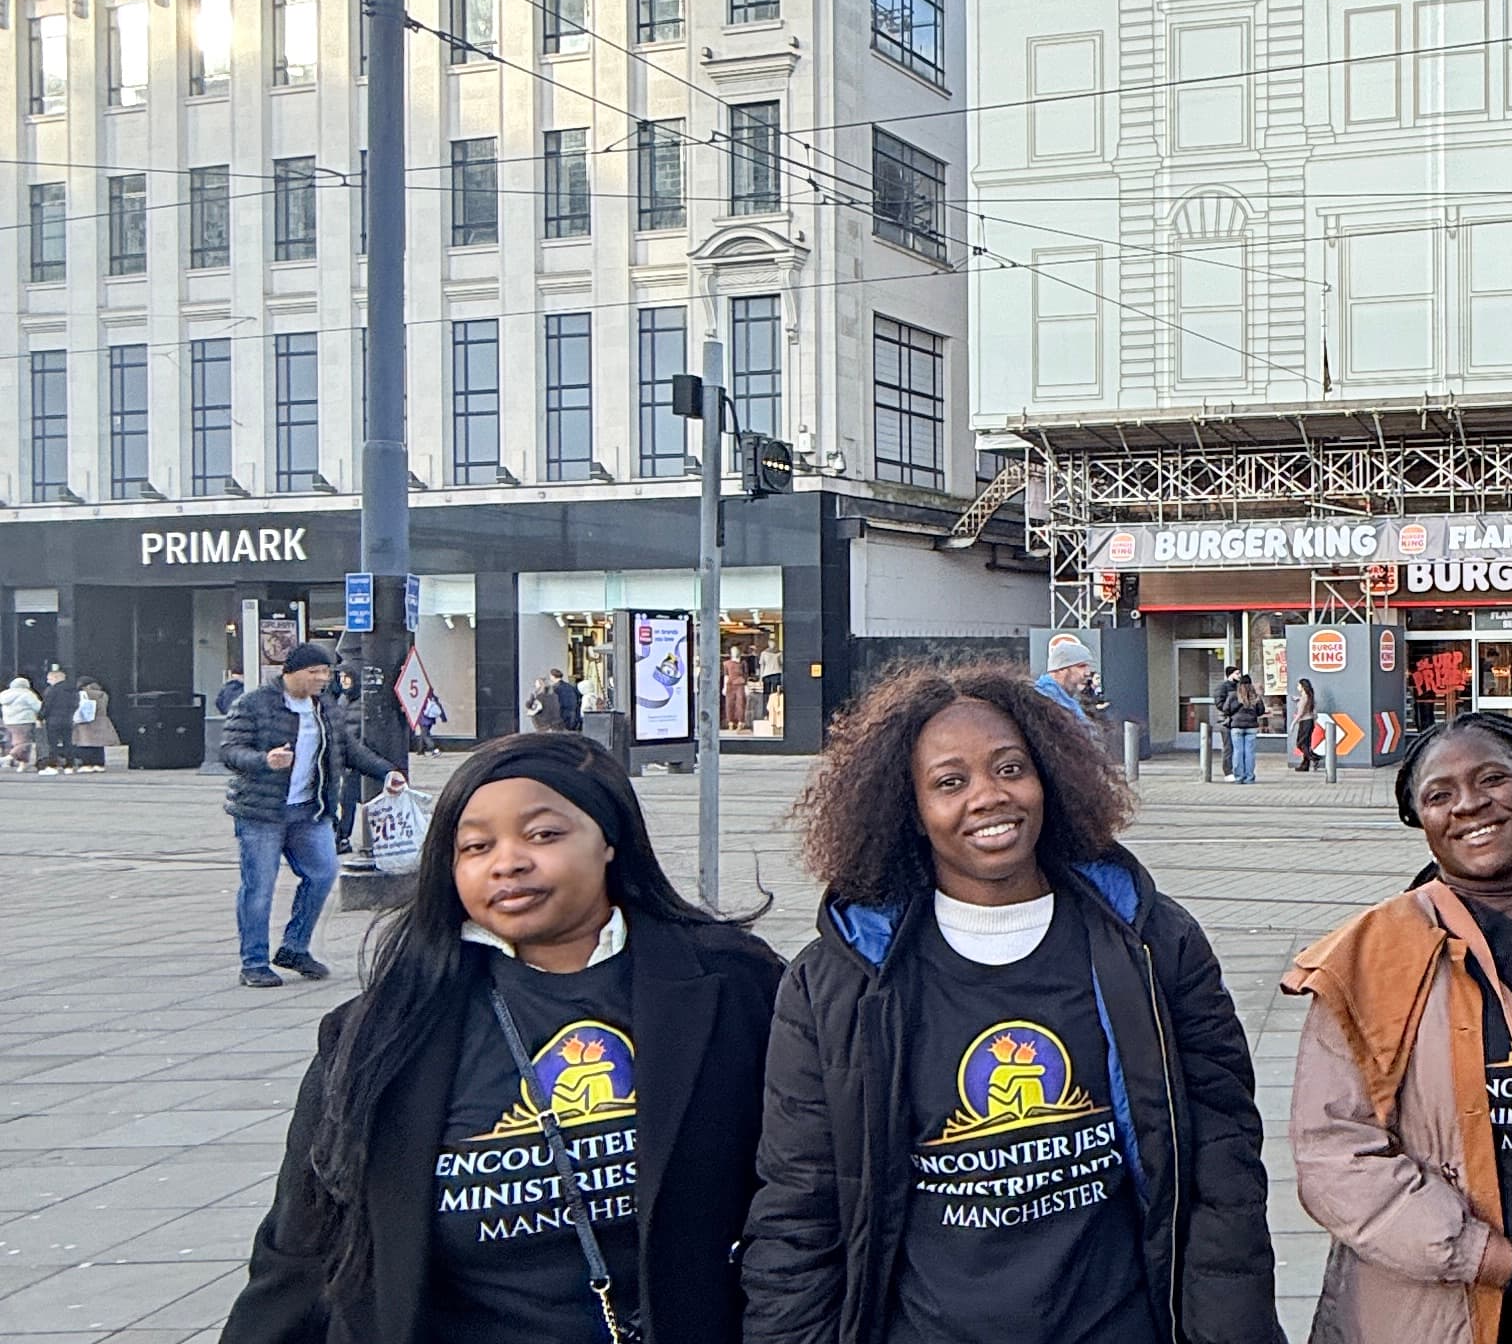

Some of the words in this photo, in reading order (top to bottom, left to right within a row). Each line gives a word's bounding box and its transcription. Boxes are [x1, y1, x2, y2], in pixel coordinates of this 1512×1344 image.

[141, 528, 307, 565] PRIMARK
[1154, 527, 1289, 561] BURGER
[1293, 525, 1377, 558] KING
[1312, 653, 1344, 662] KING
[409, 679, 419, 698] 5
[942, 1181, 1108, 1228] MANCHESTER
